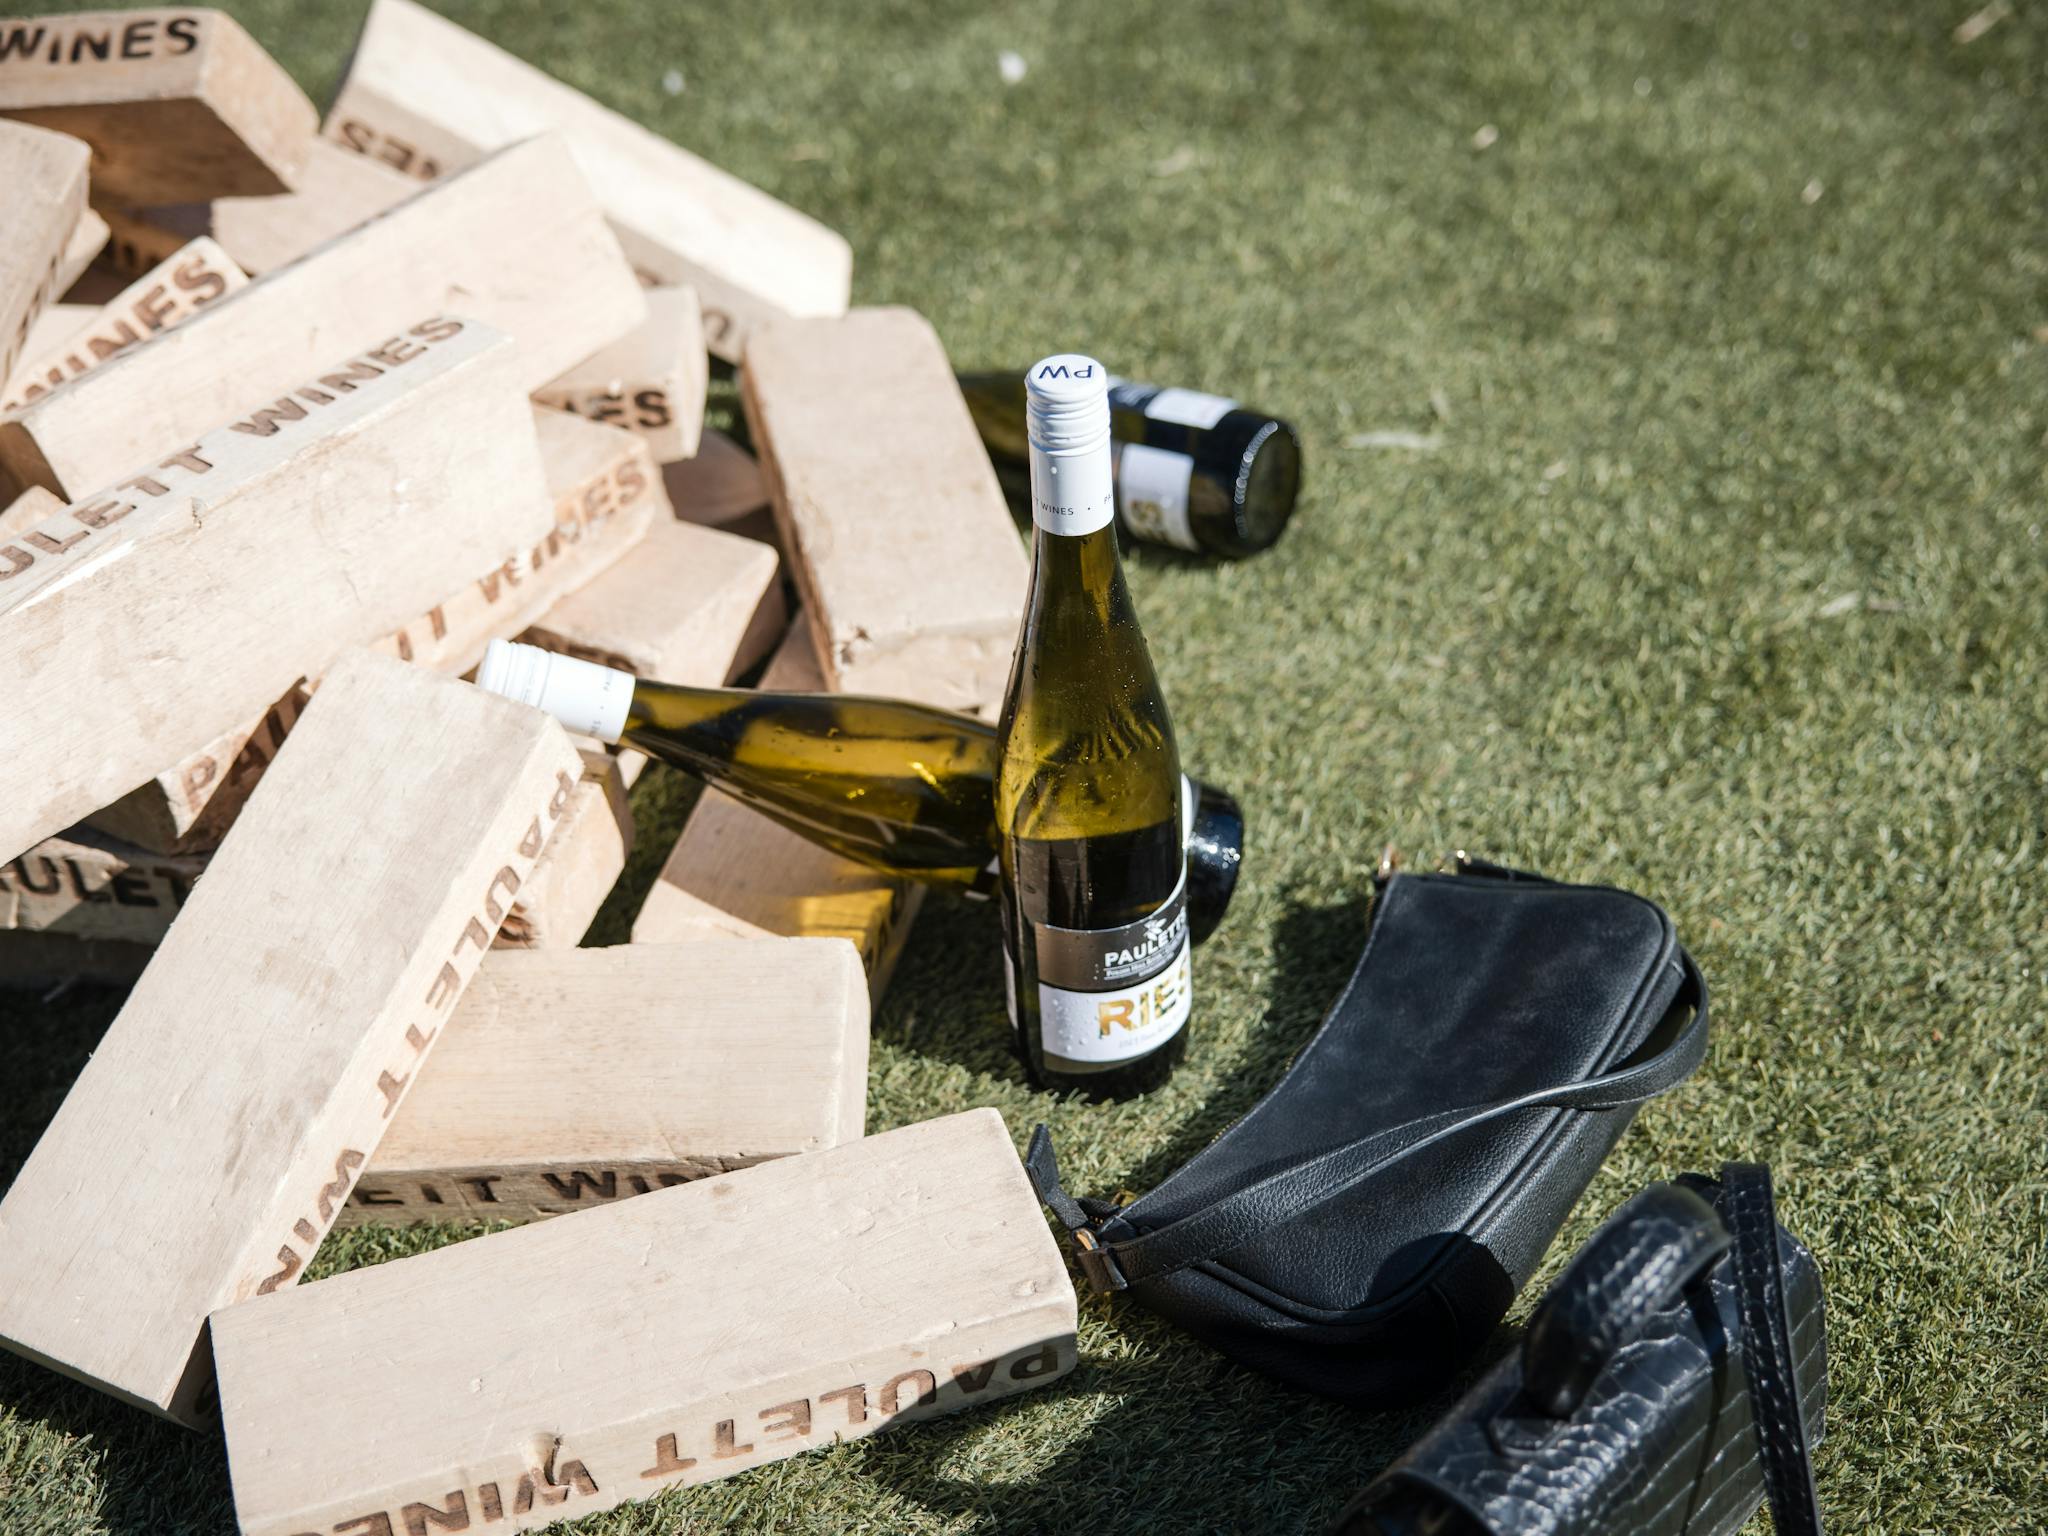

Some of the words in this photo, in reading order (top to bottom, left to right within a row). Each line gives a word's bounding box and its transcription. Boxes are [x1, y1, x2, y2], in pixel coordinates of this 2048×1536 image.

[0, 18, 199, 64] WINES
[229, 317, 465, 437] WINES
[1038, 364, 1093, 380] PW
[1040, 502, 1074, 516] WINES
[0, 856, 203, 908] ULET
[376, 769, 577, 1119] PAULETT
[641, 1345, 1059, 1479] PAULETT
[290, 1459, 599, 1536] WINE
